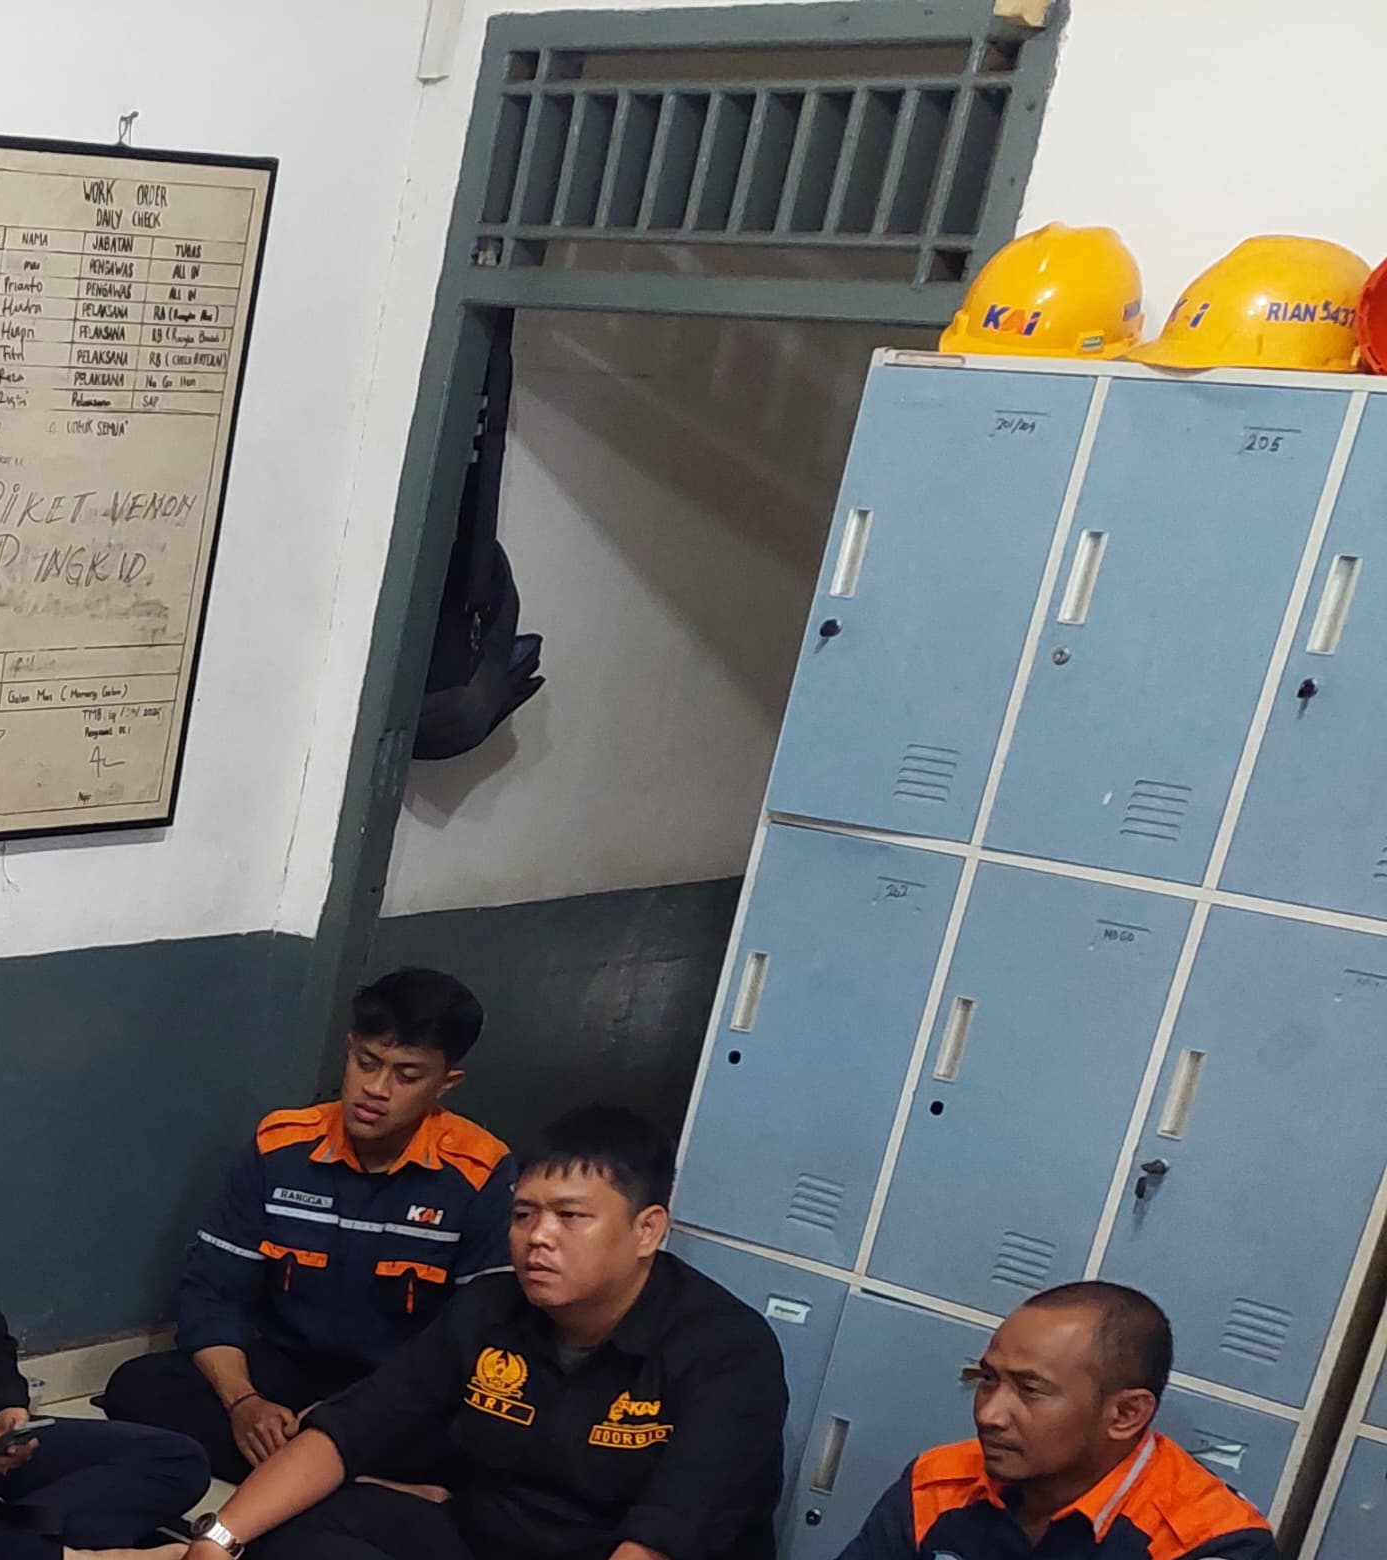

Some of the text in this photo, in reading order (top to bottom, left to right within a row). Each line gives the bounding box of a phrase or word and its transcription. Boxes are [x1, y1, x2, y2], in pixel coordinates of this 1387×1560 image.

[83, 179, 168, 207] WORK ORDER
[95, 208, 161, 230] DAILY CHECK
[21, 232, 49, 247] NAMA
[92, 235, 134, 252] JABATAN
[89, 256, 134, 278] PENGAWAS
[86, 283, 131, 299] PENGAWAS
[1265, 302, 1317, 323] RIAN
[77, 348, 128, 366] PELAKSANA
[1245, 436, 1284, 453] 205
[470, 1391, 513, 1414] ARY
